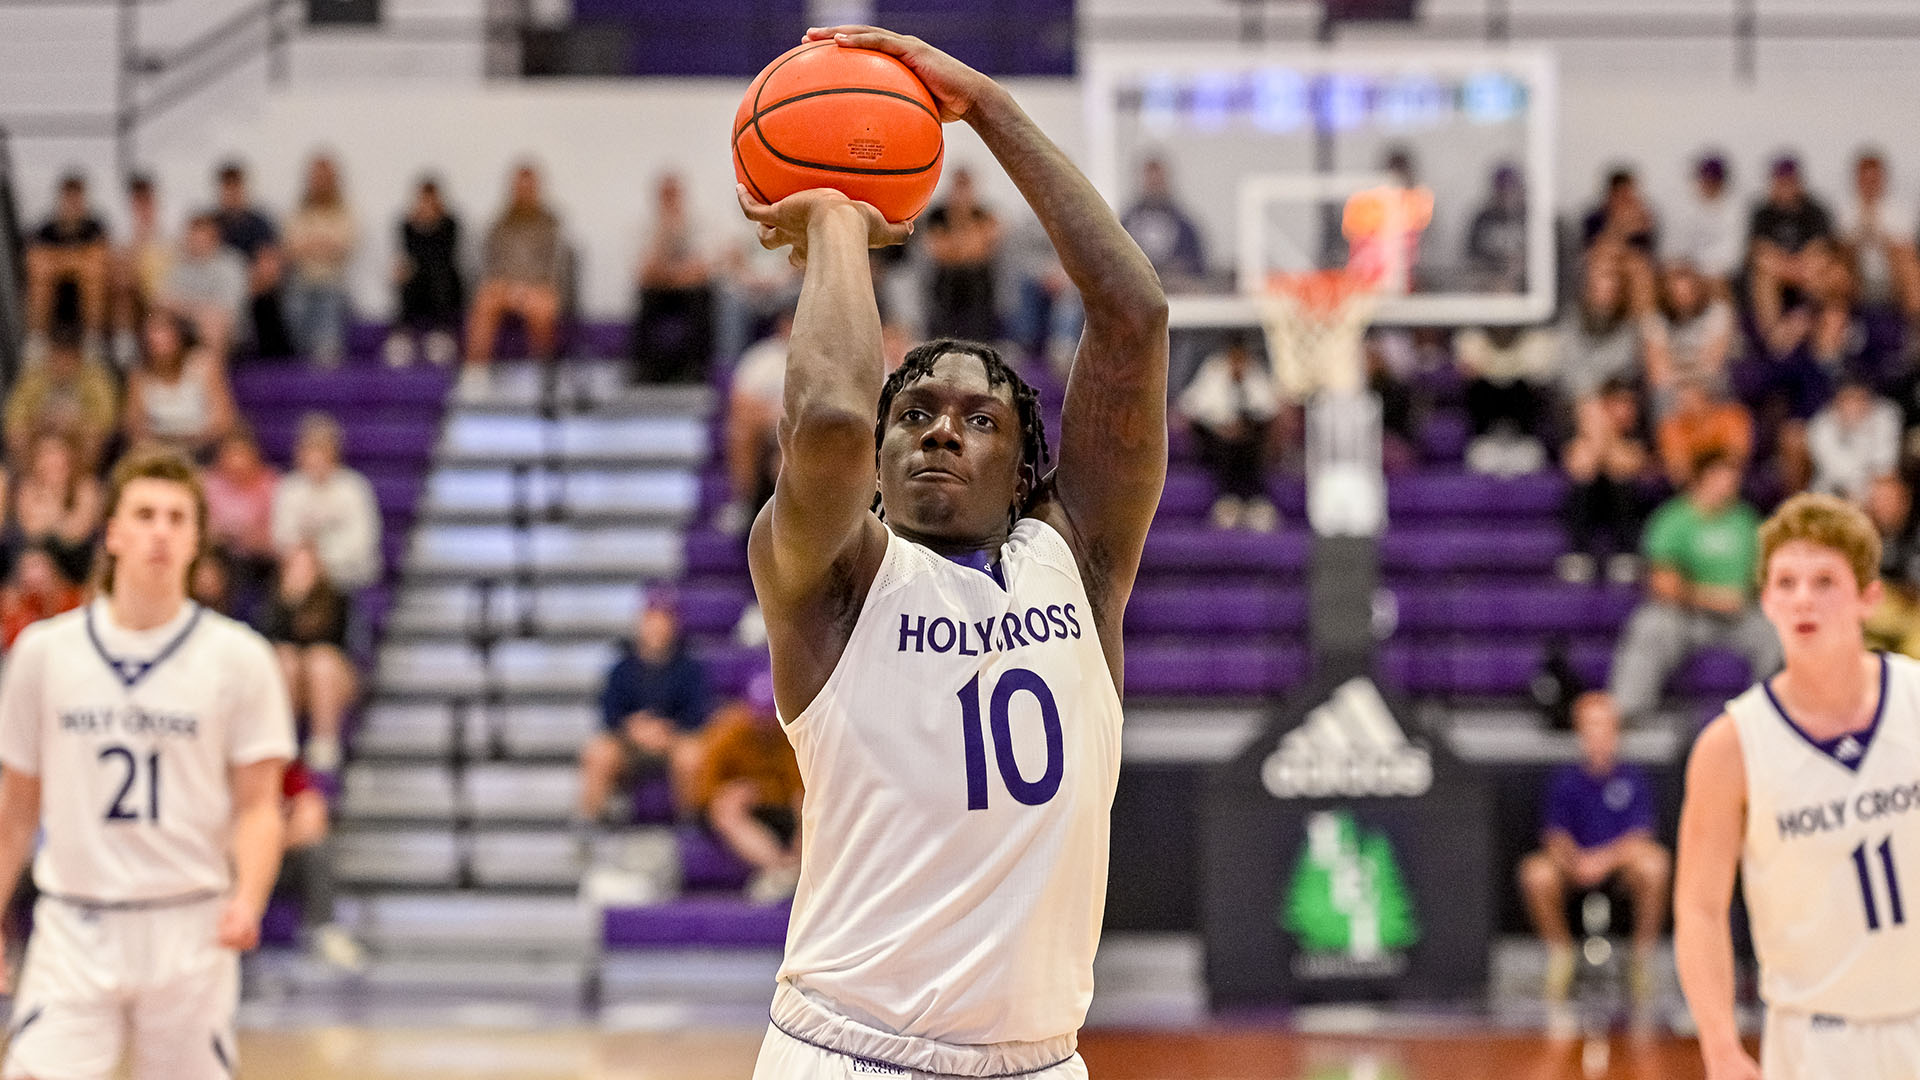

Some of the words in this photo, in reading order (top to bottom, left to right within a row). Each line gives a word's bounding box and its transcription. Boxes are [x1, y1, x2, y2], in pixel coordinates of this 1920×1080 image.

[898, 613, 995, 656] HOLY
[996, 603, 1081, 652] ROSS
[956, 668, 1064, 811] 10
[98, 745, 159, 824] 21
[1776, 799, 1845, 841] HOLY
[1851, 833, 1905, 931] 11
